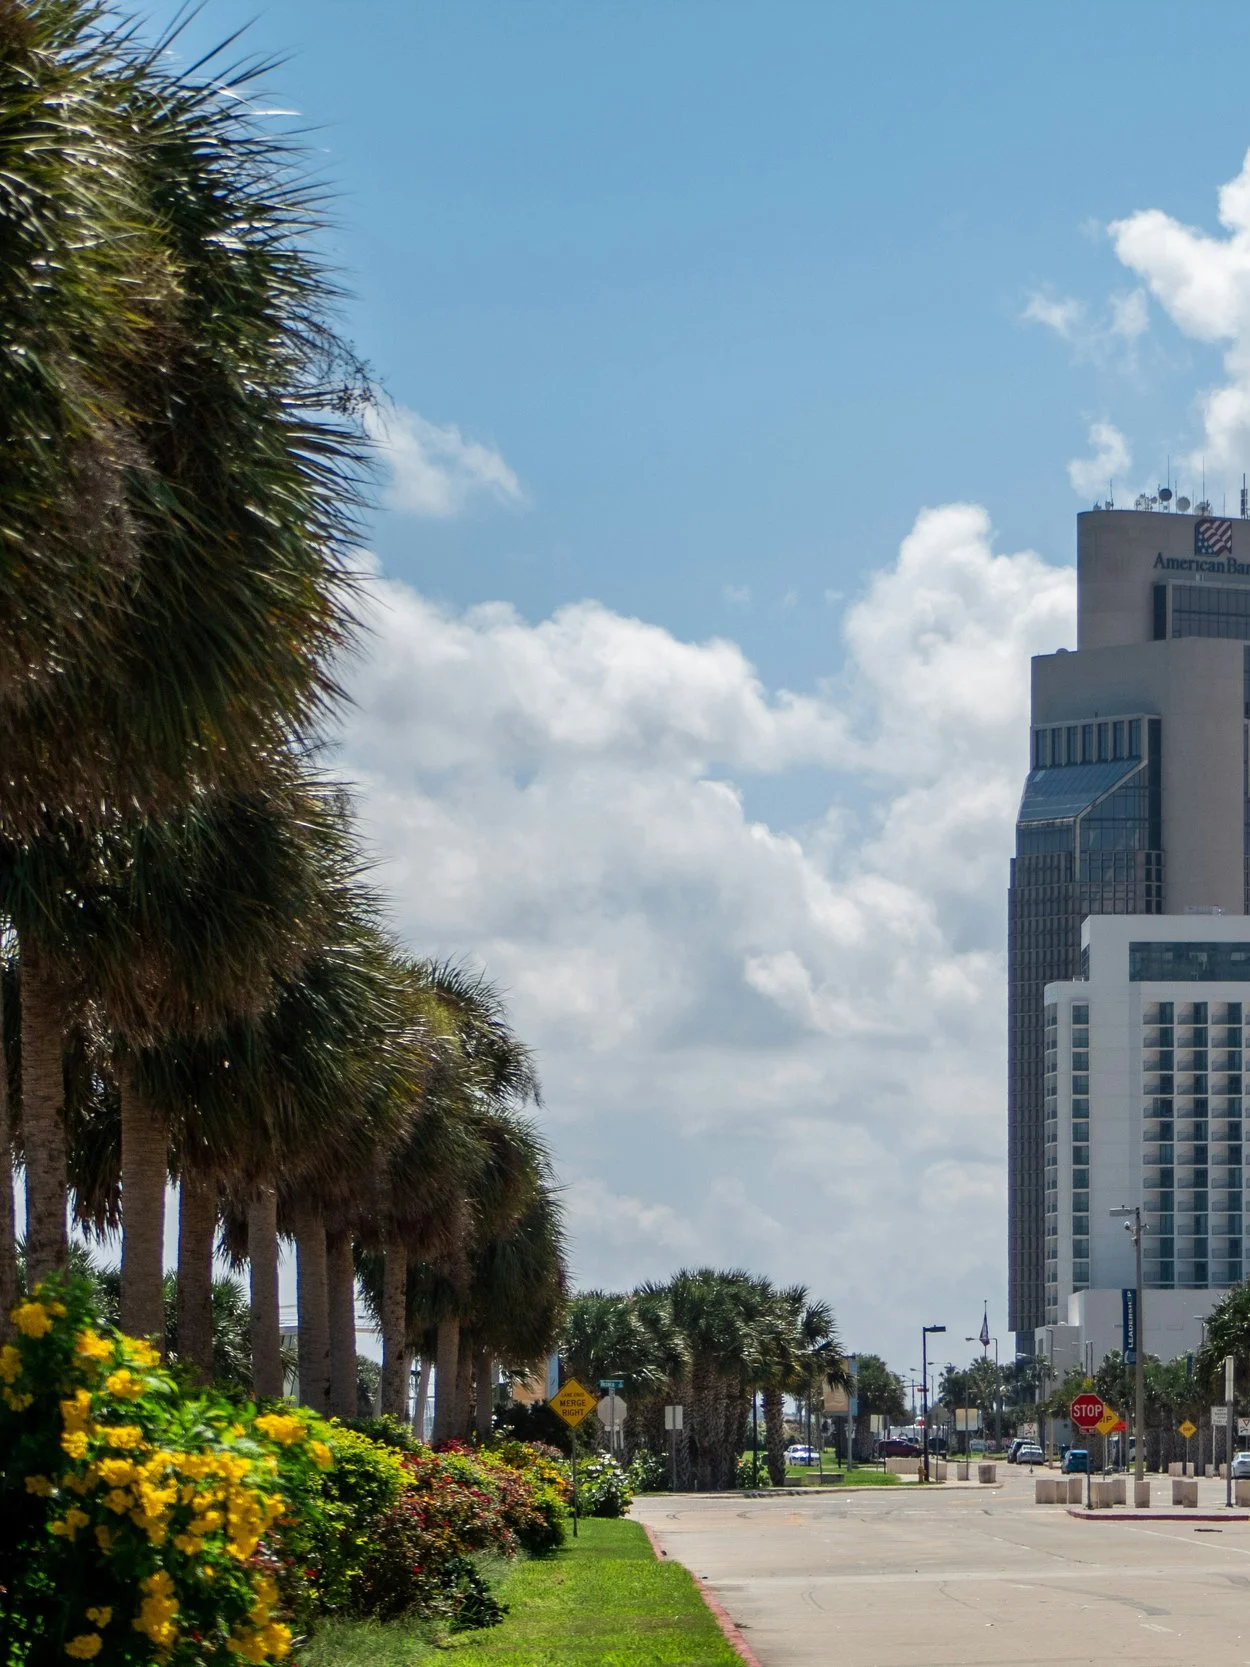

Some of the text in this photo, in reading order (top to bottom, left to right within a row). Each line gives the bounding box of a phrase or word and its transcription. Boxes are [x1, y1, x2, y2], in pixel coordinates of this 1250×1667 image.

[559, 1399, 586, 1407] MERGE
[562, 1408, 584, 1416] RIGHT
[1073, 1404, 1102, 1417] STOP
[1100, 1415, 1112, 1423] IP
